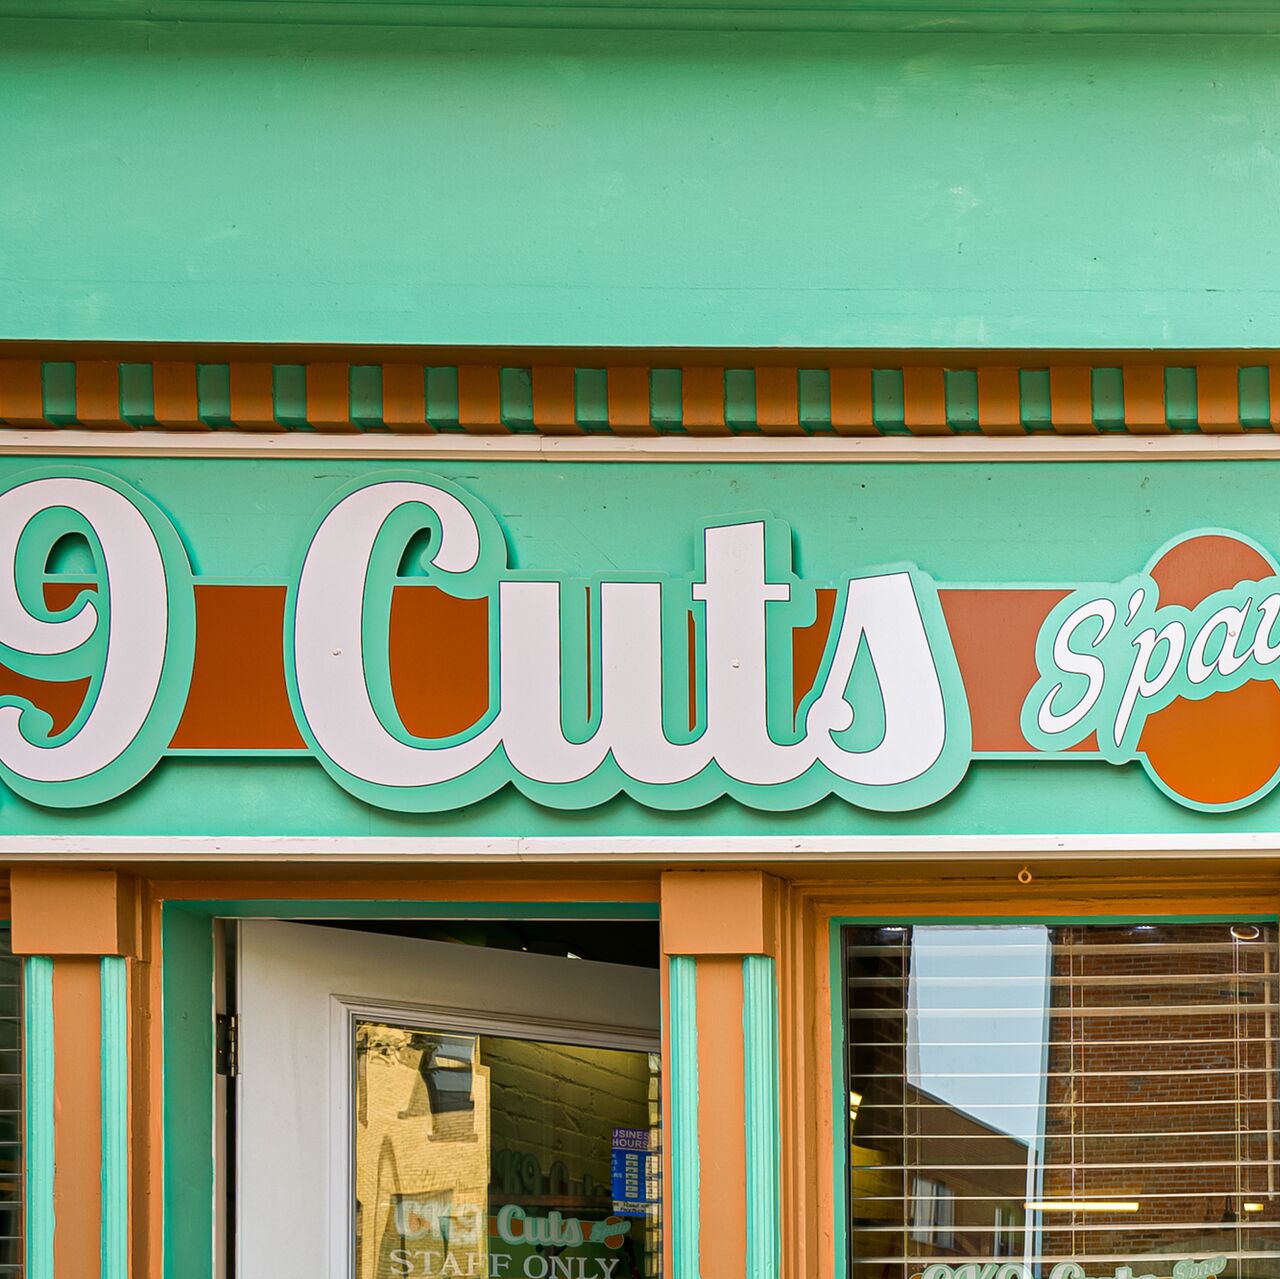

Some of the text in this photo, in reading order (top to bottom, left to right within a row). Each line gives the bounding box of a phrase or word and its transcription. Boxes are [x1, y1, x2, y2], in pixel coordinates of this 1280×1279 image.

[294, 480, 946, 788] Cuts
[499, 1205, 581, 1244] Cuts
[389, 1249, 512, 1278] STAFF
